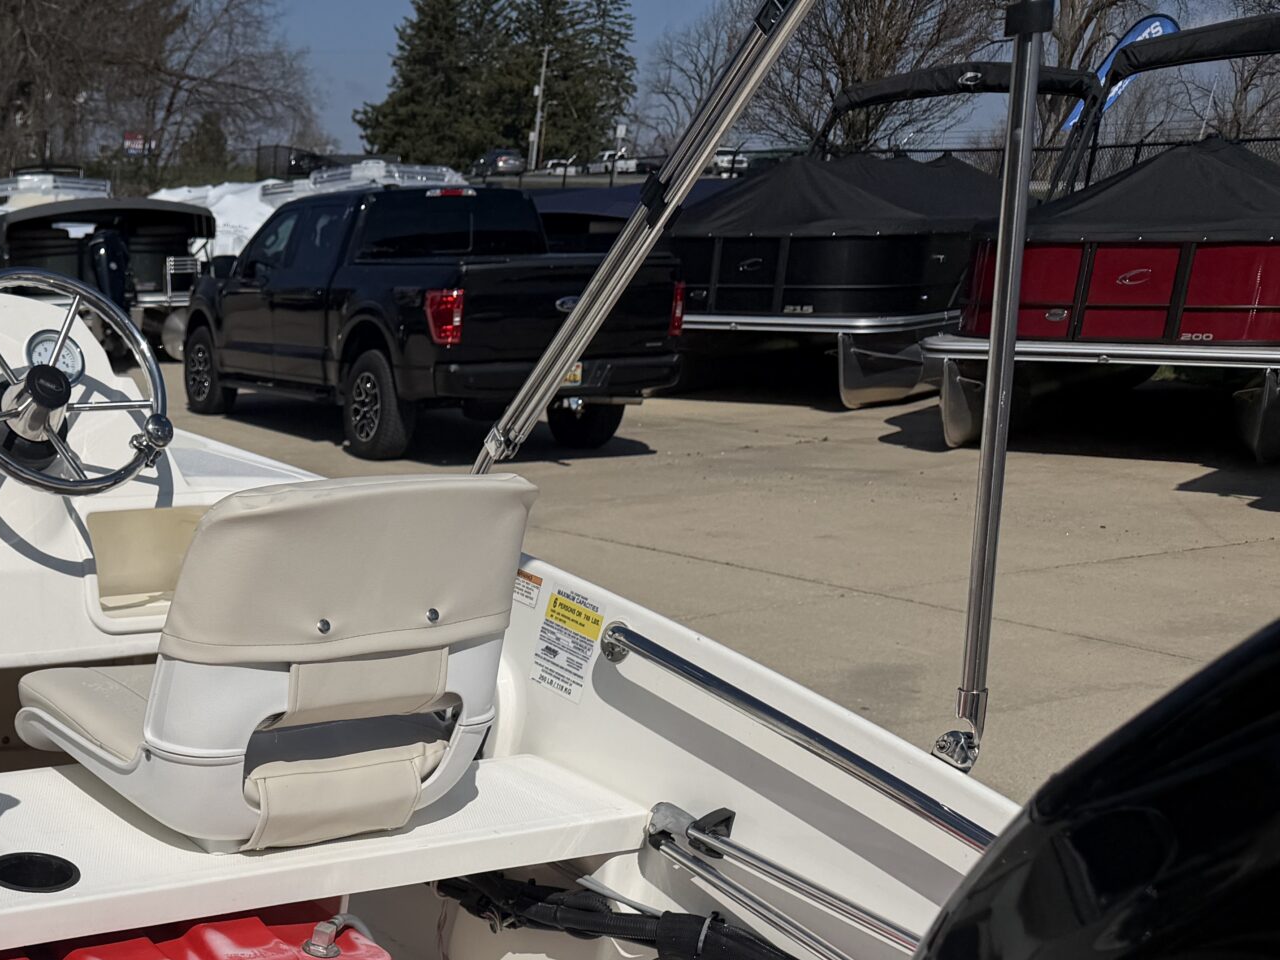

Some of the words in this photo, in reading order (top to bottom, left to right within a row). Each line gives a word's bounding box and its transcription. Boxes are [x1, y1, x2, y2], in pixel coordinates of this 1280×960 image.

[1180, 333, 1213, 341] 200
[558, 590, 575, 601] MAXIMUM
[576, 598, 599, 612] CAPACITIES
[558, 602, 576, 614] PERSONS
